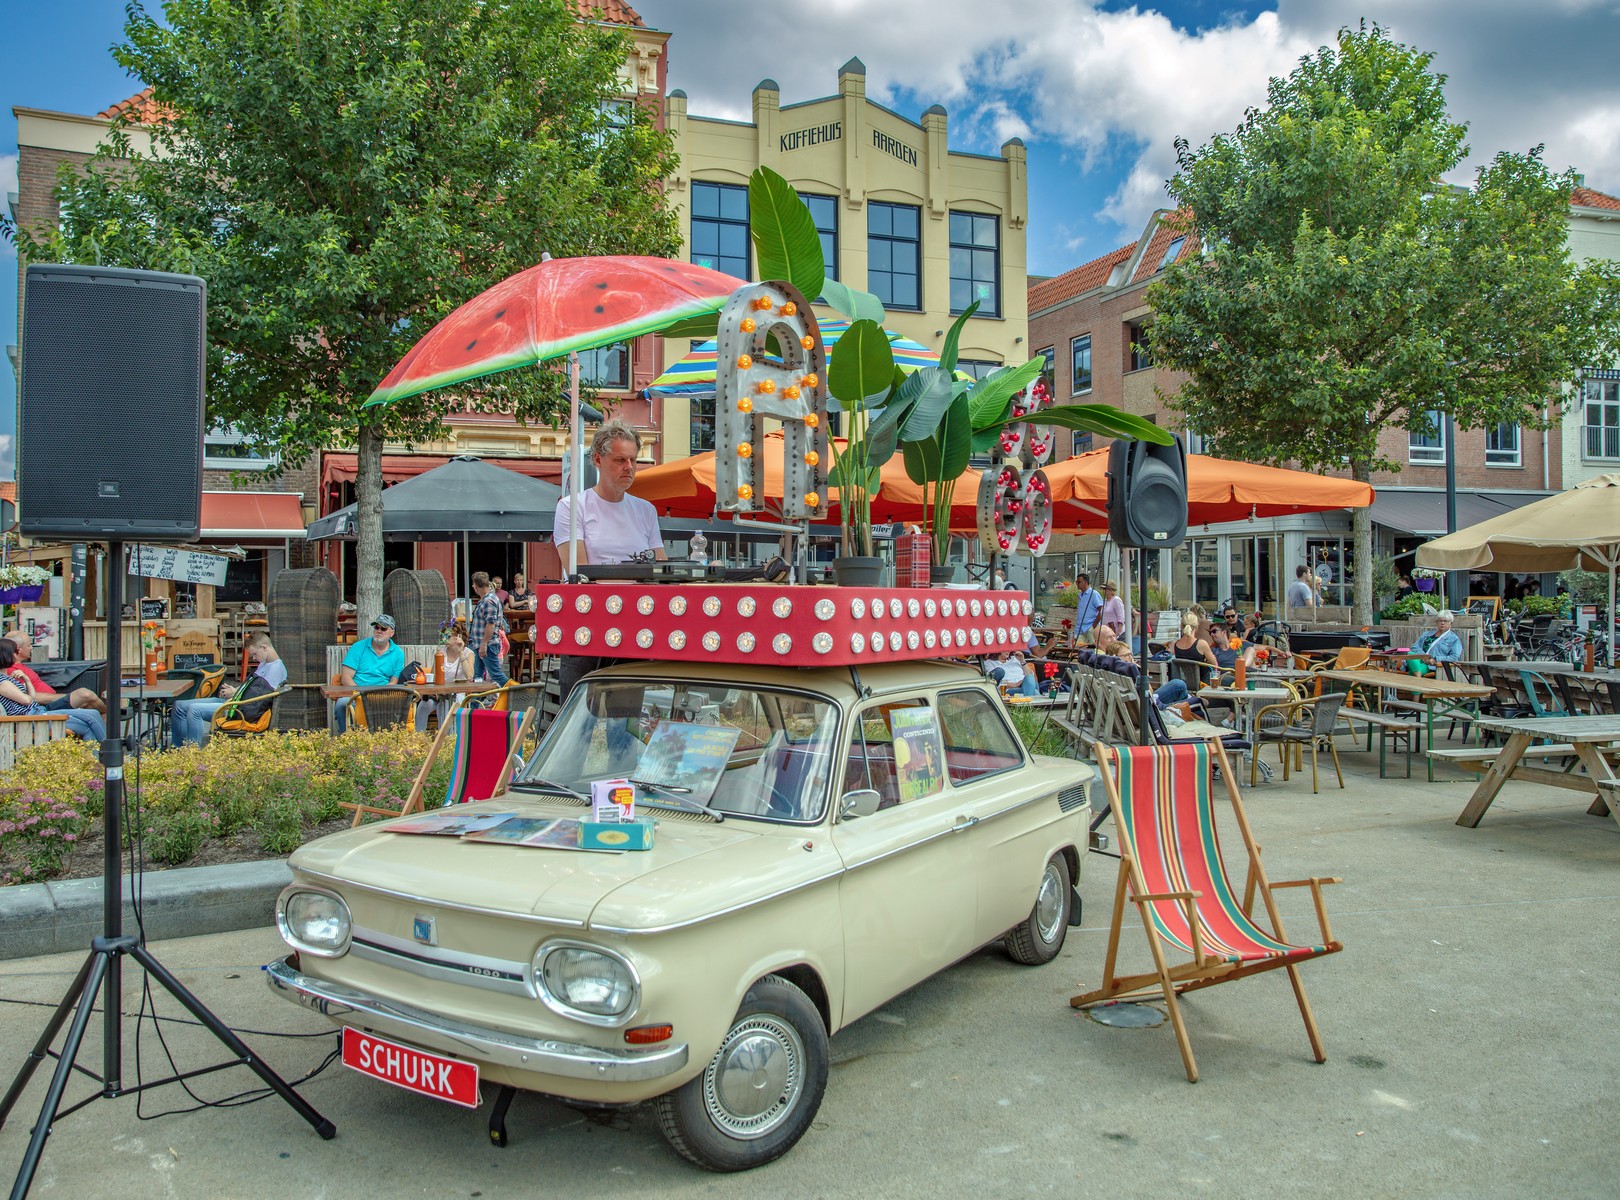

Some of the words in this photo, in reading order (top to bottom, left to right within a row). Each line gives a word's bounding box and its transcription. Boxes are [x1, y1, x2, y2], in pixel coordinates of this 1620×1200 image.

[780, 121, 842, 152] KOFFIEHUIS
[872, 129, 917, 167] AARDEN
[715, 279, 828, 520] A
[871, 525, 891, 534] piler
[468, 966, 500, 978] 1000
[359, 1038, 454, 1096] SCHURK
